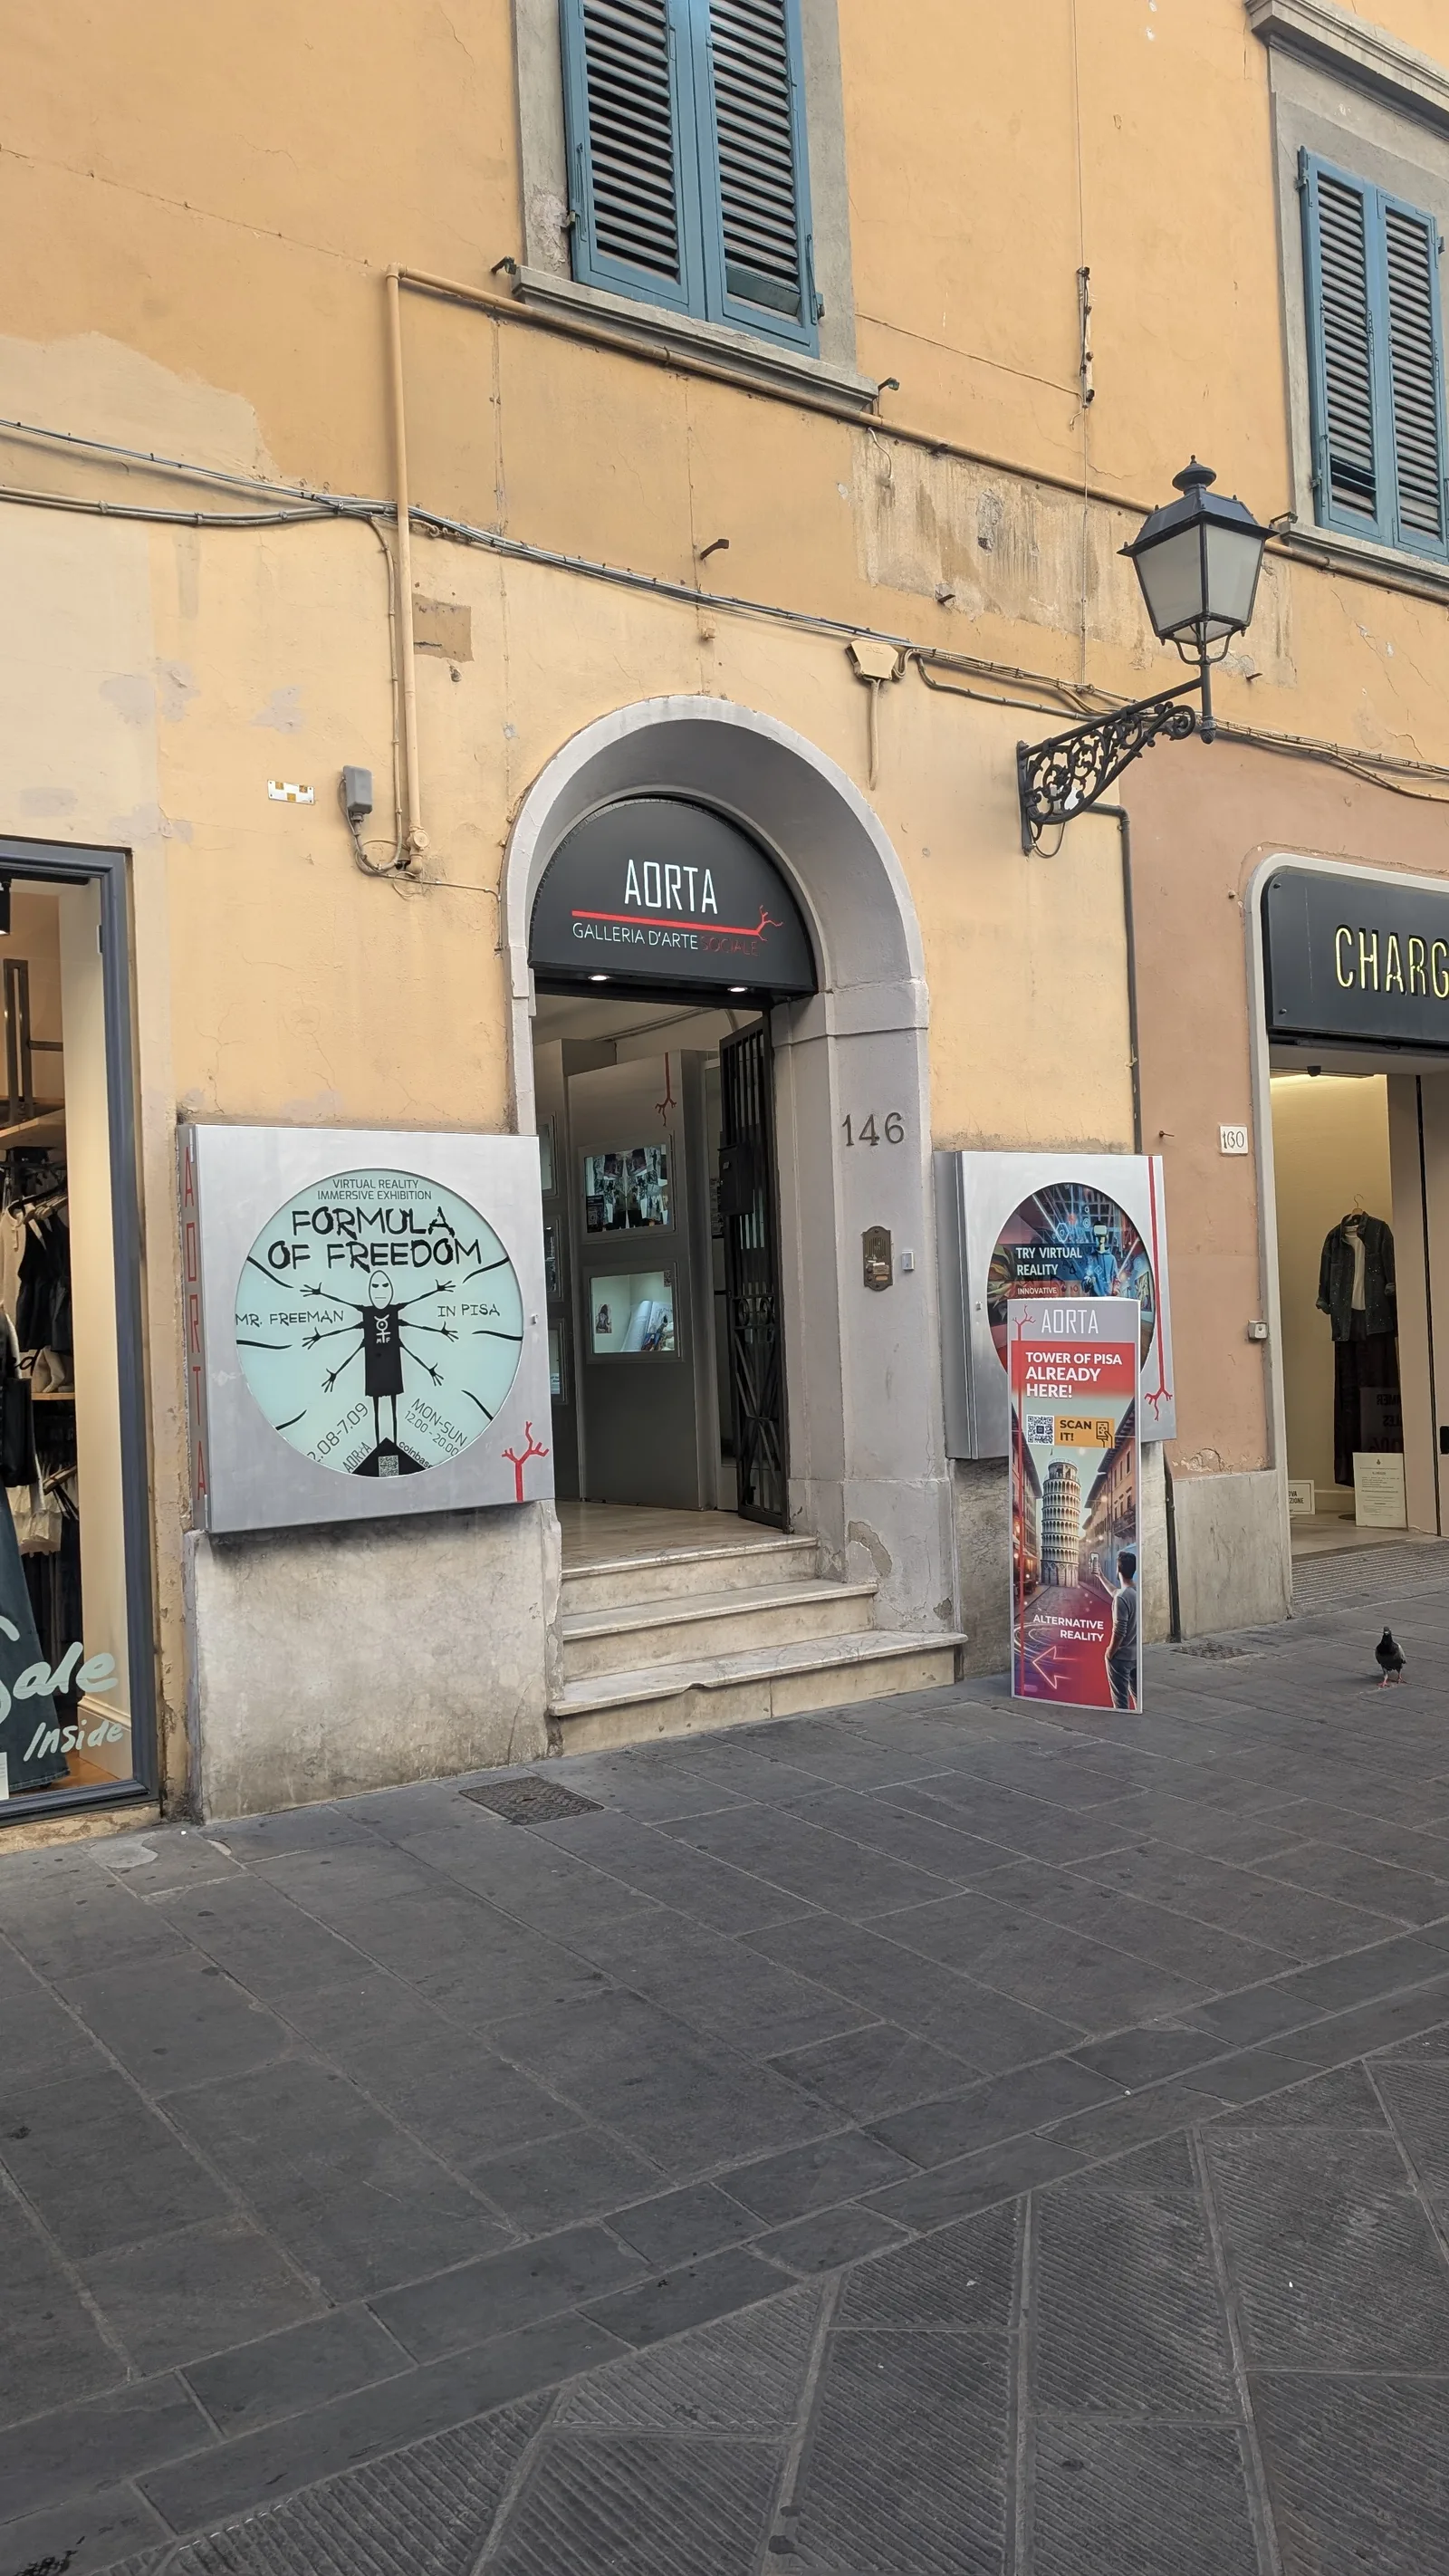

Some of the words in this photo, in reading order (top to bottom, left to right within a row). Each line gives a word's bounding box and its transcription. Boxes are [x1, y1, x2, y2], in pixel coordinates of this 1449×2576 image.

[624, 859, 718, 914] AORTA
[572, 922, 646, 945] GALLERIA
[648, 930, 698, 950] D'ARTE
[701, 936, 759, 956] SOCIALE
[842, 1112, 905, 1147] 146
[1223, 1130, 1245, 1149] 160
[332, 1178, 377, 1189] VIRTUAL
[379, 1179, 418, 1189] REALITY
[317, 1190, 374, 1200] IMMERSIVE
[377, 1190, 432, 1200] EXHIBITION
[292, 1206, 455, 1241] FORMULA
[268, 1240, 311, 1270] OF
[326, 1237, 482, 1274] FREEDOM
[1015, 1246, 1036, 1259] TRY
[1039, 1246, 1083, 1259] VIRTUAL
[1016, 1264, 1059, 1276] REALITY
[1017, 1287, 1058, 1295] INNOVATIVE
[437, 1305, 456, 1317] IN
[461, 1303, 501, 1316] PISA
[235, 1312, 263, 1328] MR.
[269, 1310, 344, 1326] FREEMAN
[1041, 1309, 1099, 1334] AORTA
[1025, 1351, 1070, 1364] TOWER
[1073, 1353, 1091, 1365] OF
[1093, 1353, 1123, 1365] PISA
[1025, 1366, 1101, 1382] ALREADY
[1026, 1383, 1072, 1399] HERE!
[410, 1398, 468, 1447] MON-SUN
[1060, 1419, 1092, 1430] SCAN
[404, 1410, 429, 1434] 12.00
[432, 1433, 459, 1456] 20.00
[1060, 1432, 1074, 1442] IT!
[1032, 1614, 1104, 1629] ALTERNATIVE
[1060, 1629, 1104, 1642] REALITY
[23, 1719, 124, 1762] Inside
